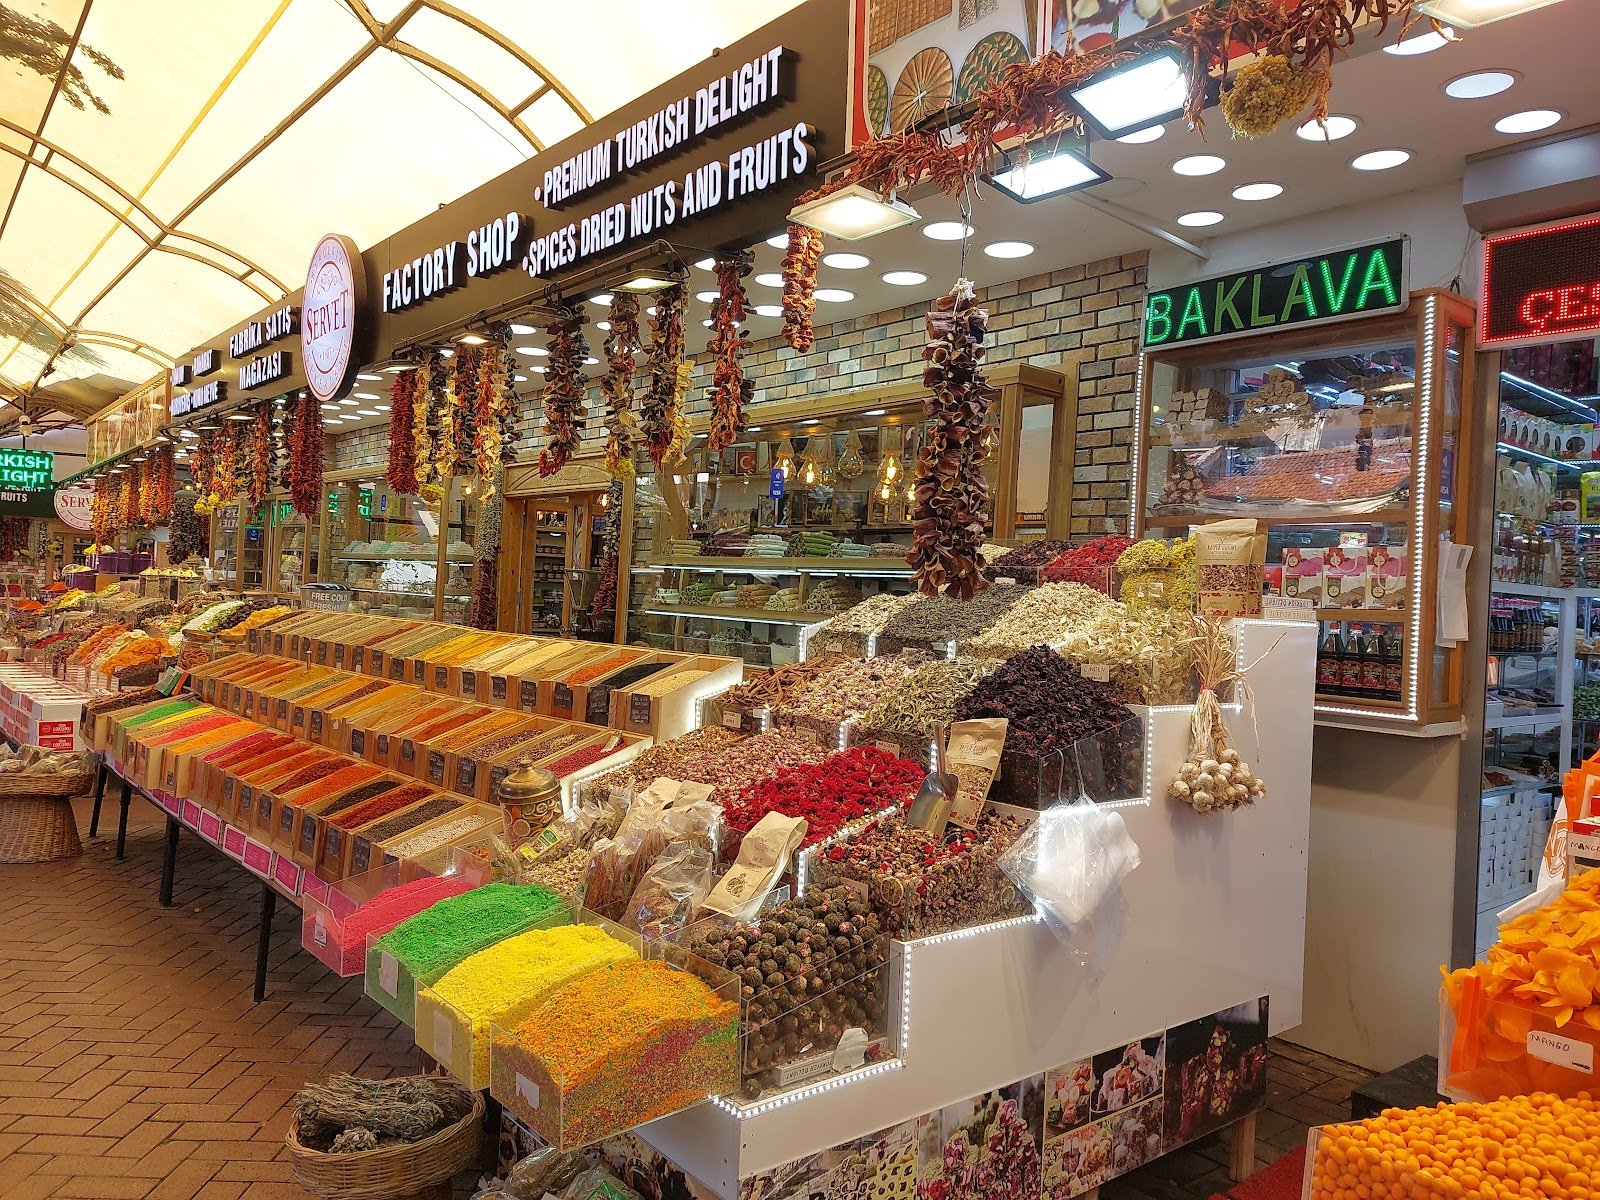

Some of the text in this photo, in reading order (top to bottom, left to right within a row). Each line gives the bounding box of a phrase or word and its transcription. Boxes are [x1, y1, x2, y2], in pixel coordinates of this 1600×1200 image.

[544, 45, 783, 208] PREMIUM TURKISH DELIGHT
[529, 122, 808, 278] SPICES DRIED NUTS AND FRUITS
[383, 241, 457, 312] FACTORY
[466, 211, 519, 278] SHOP
[306, 289, 349, 346] SERVET
[1147, 248, 1397, 345] BAKLAVA
[229, 304, 292, 359] FABRİKA SATIŞ
[239, 350, 282, 390] MAĞAZASI
[311, 592, 348, 602] FREE COLD
[1531, 1034, 1570, 1051] MANGO
